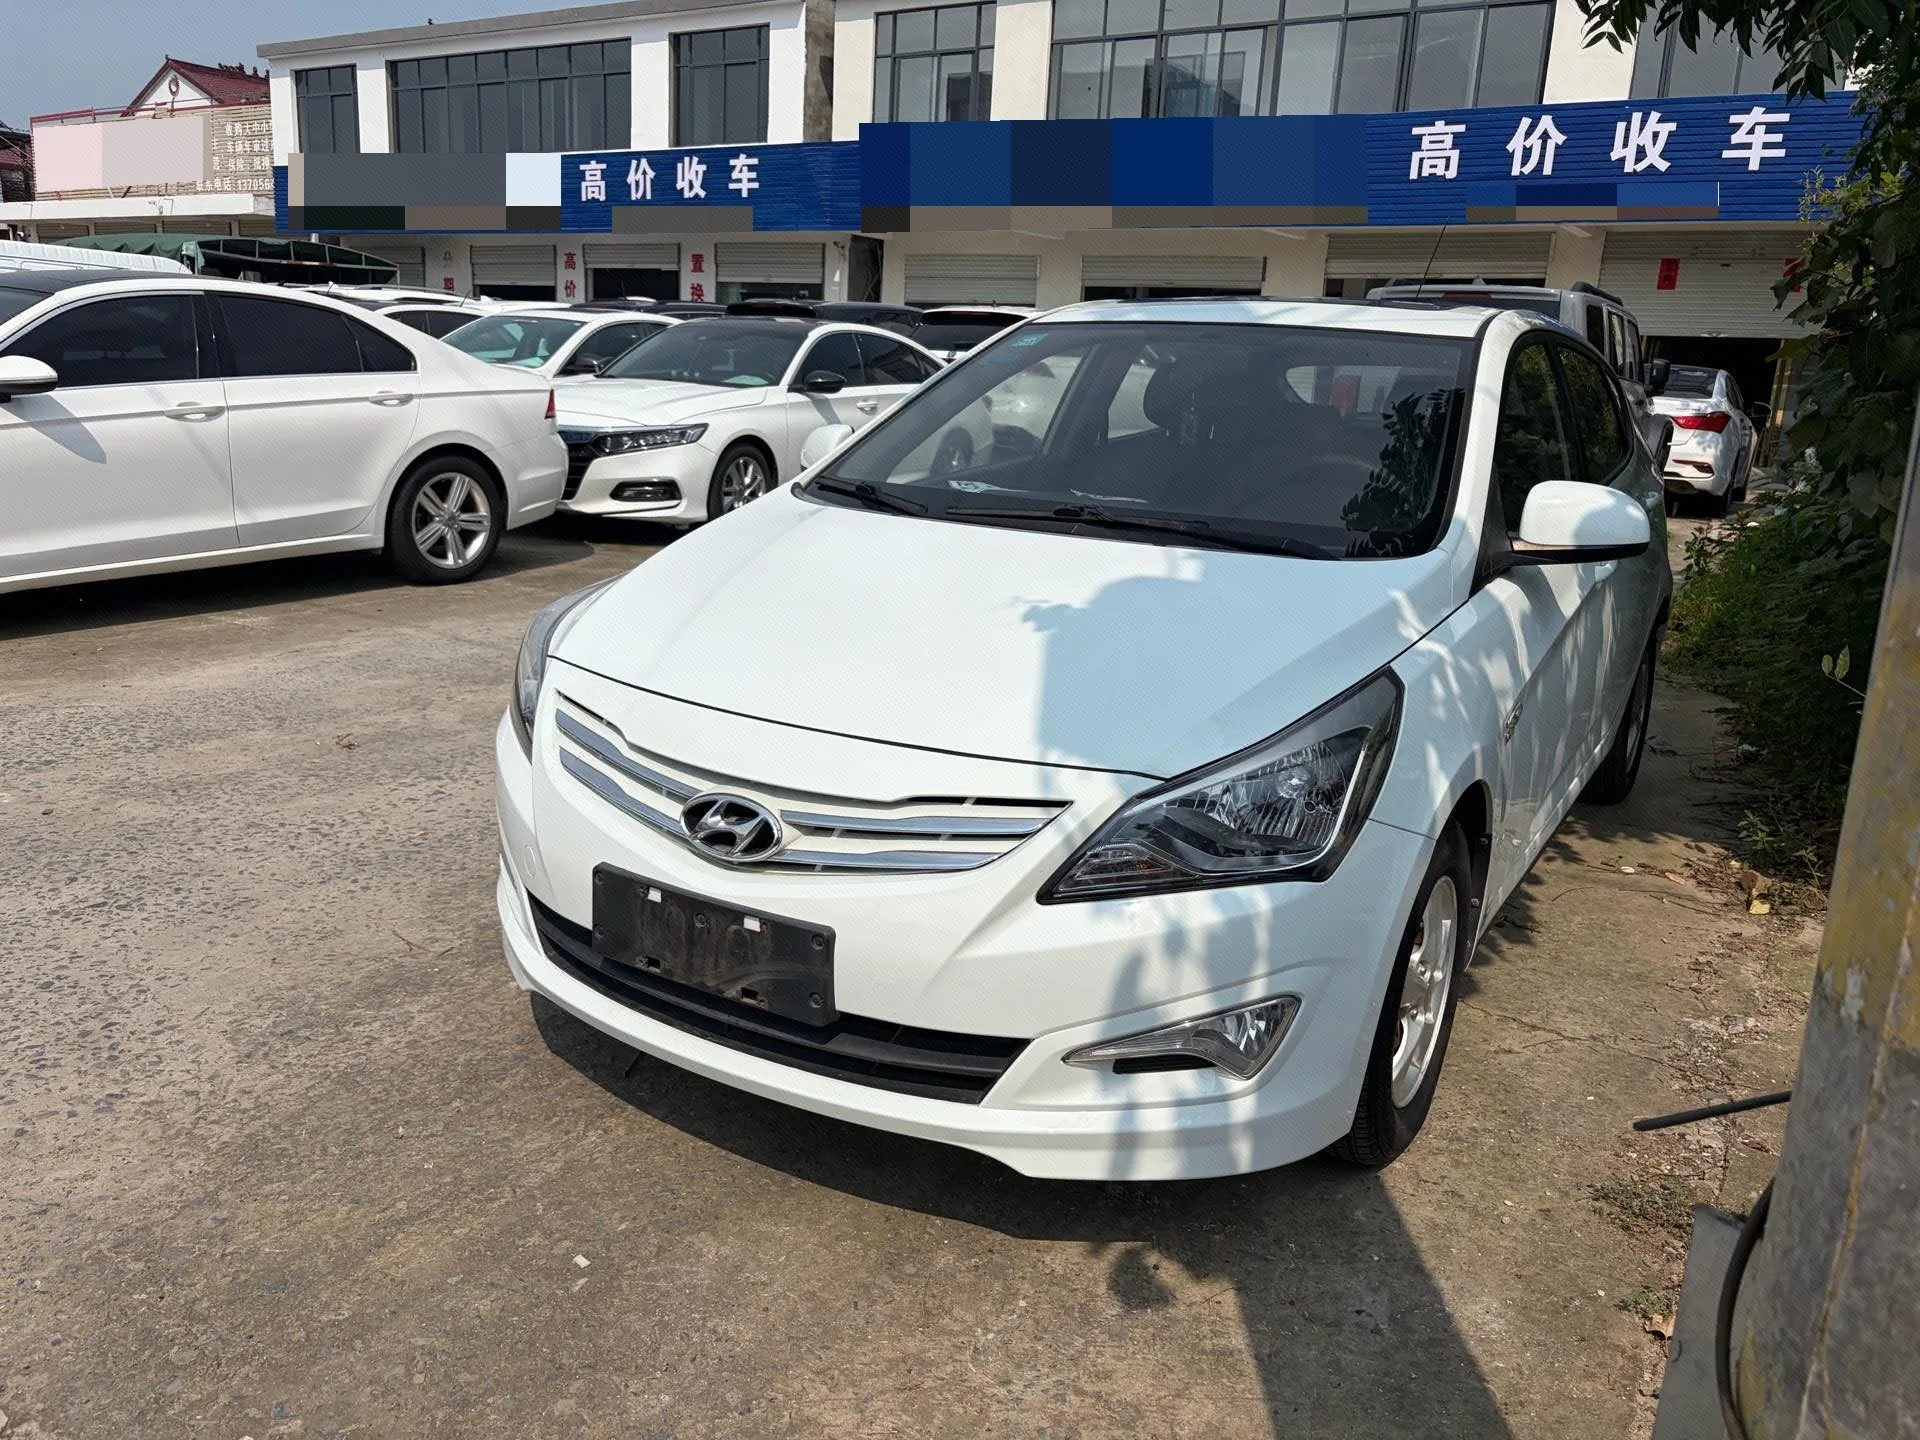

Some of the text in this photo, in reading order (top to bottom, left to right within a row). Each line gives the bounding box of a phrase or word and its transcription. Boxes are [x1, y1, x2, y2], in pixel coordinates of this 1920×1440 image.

[1409, 106, 1790, 179] 高价收车
[579, 154, 759, 202] 高价收车
[564, 252, 576, 298] 高价
